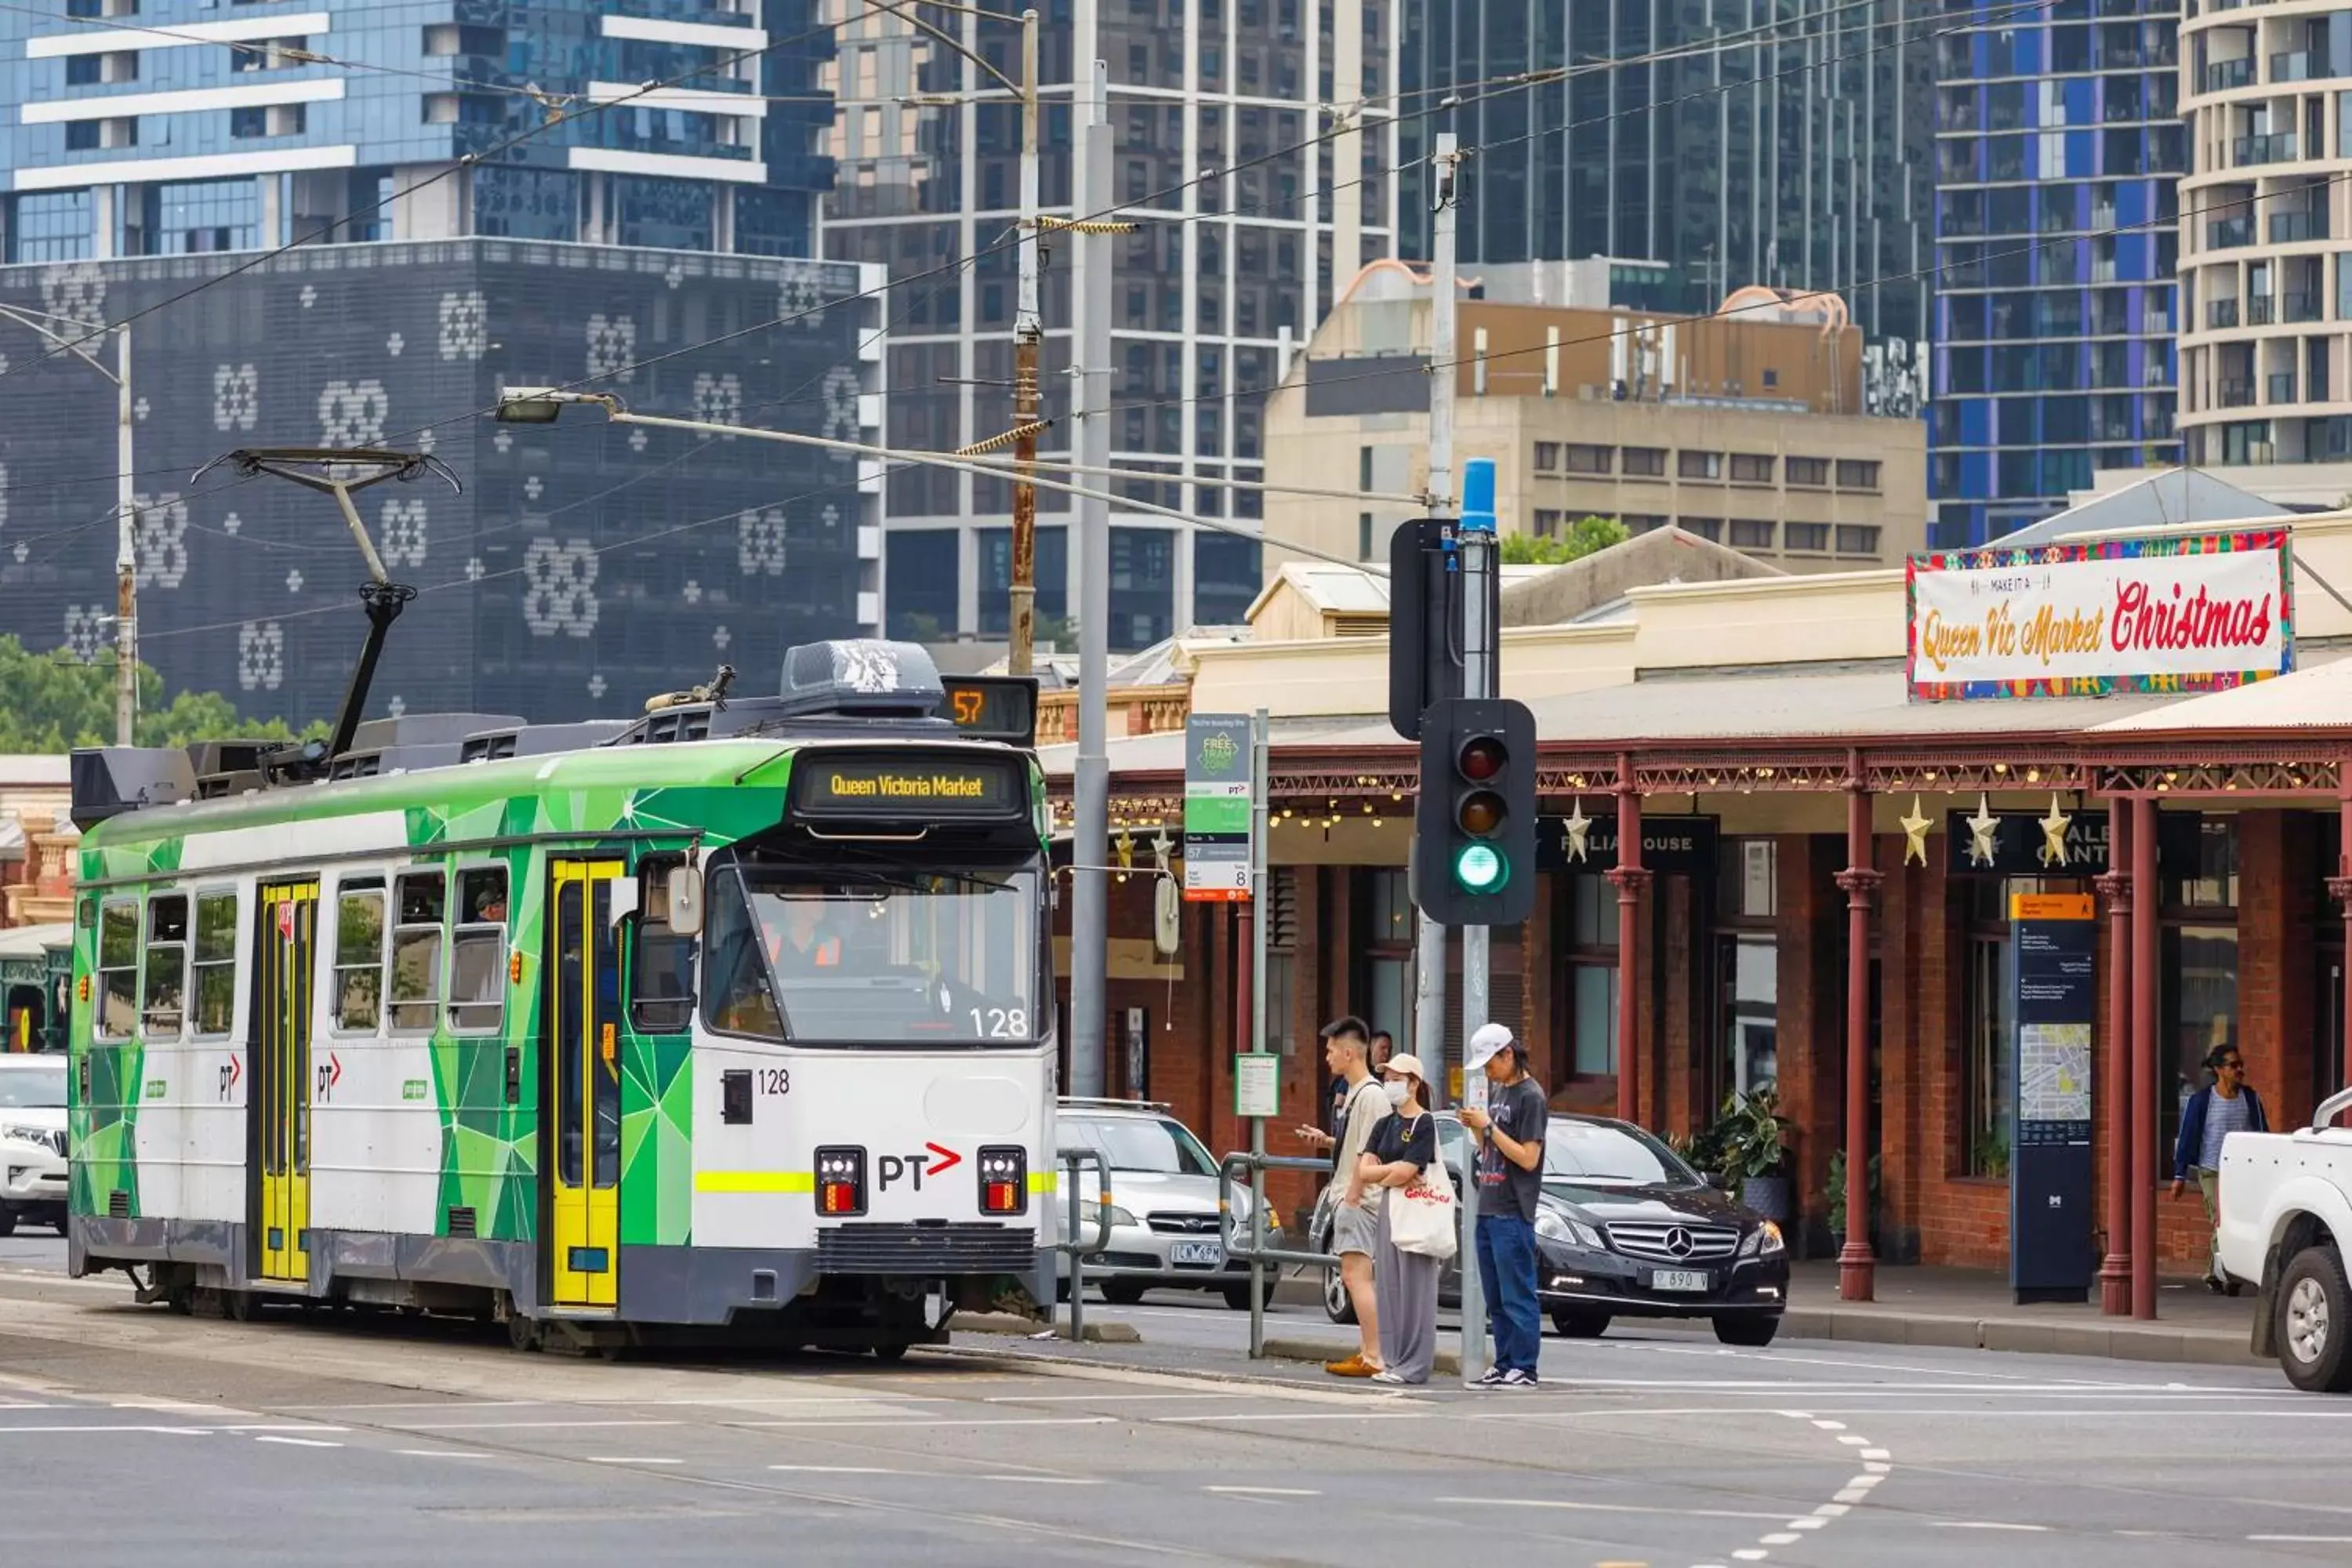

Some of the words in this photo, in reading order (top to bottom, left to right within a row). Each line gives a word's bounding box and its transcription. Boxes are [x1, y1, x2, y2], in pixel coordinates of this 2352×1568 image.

[1991, 578, 2013, 592] MAKE
[2015, 577, 2022, 592] IT
[2024, 576, 2031, 590] A
[1922, 608, 1981, 672] Queen
[1986, 599, 2016, 655] Vic
[2020, 604, 2104, 666] Market
[2111, 578, 2271, 652] Christmas
[953, 691, 983, 723] 57
[1203, 738, 1232, 748] FREE
[832, 775, 877, 797] Queen
[878, 775, 931, 797] Victoria
[933, 775, 983, 797] Market
[1188, 847, 1201, 859] 57
[1236, 871, 1246, 887] 8
[970, 1007, 1029, 1039] 128
[758, 1069, 790, 1095] 128
